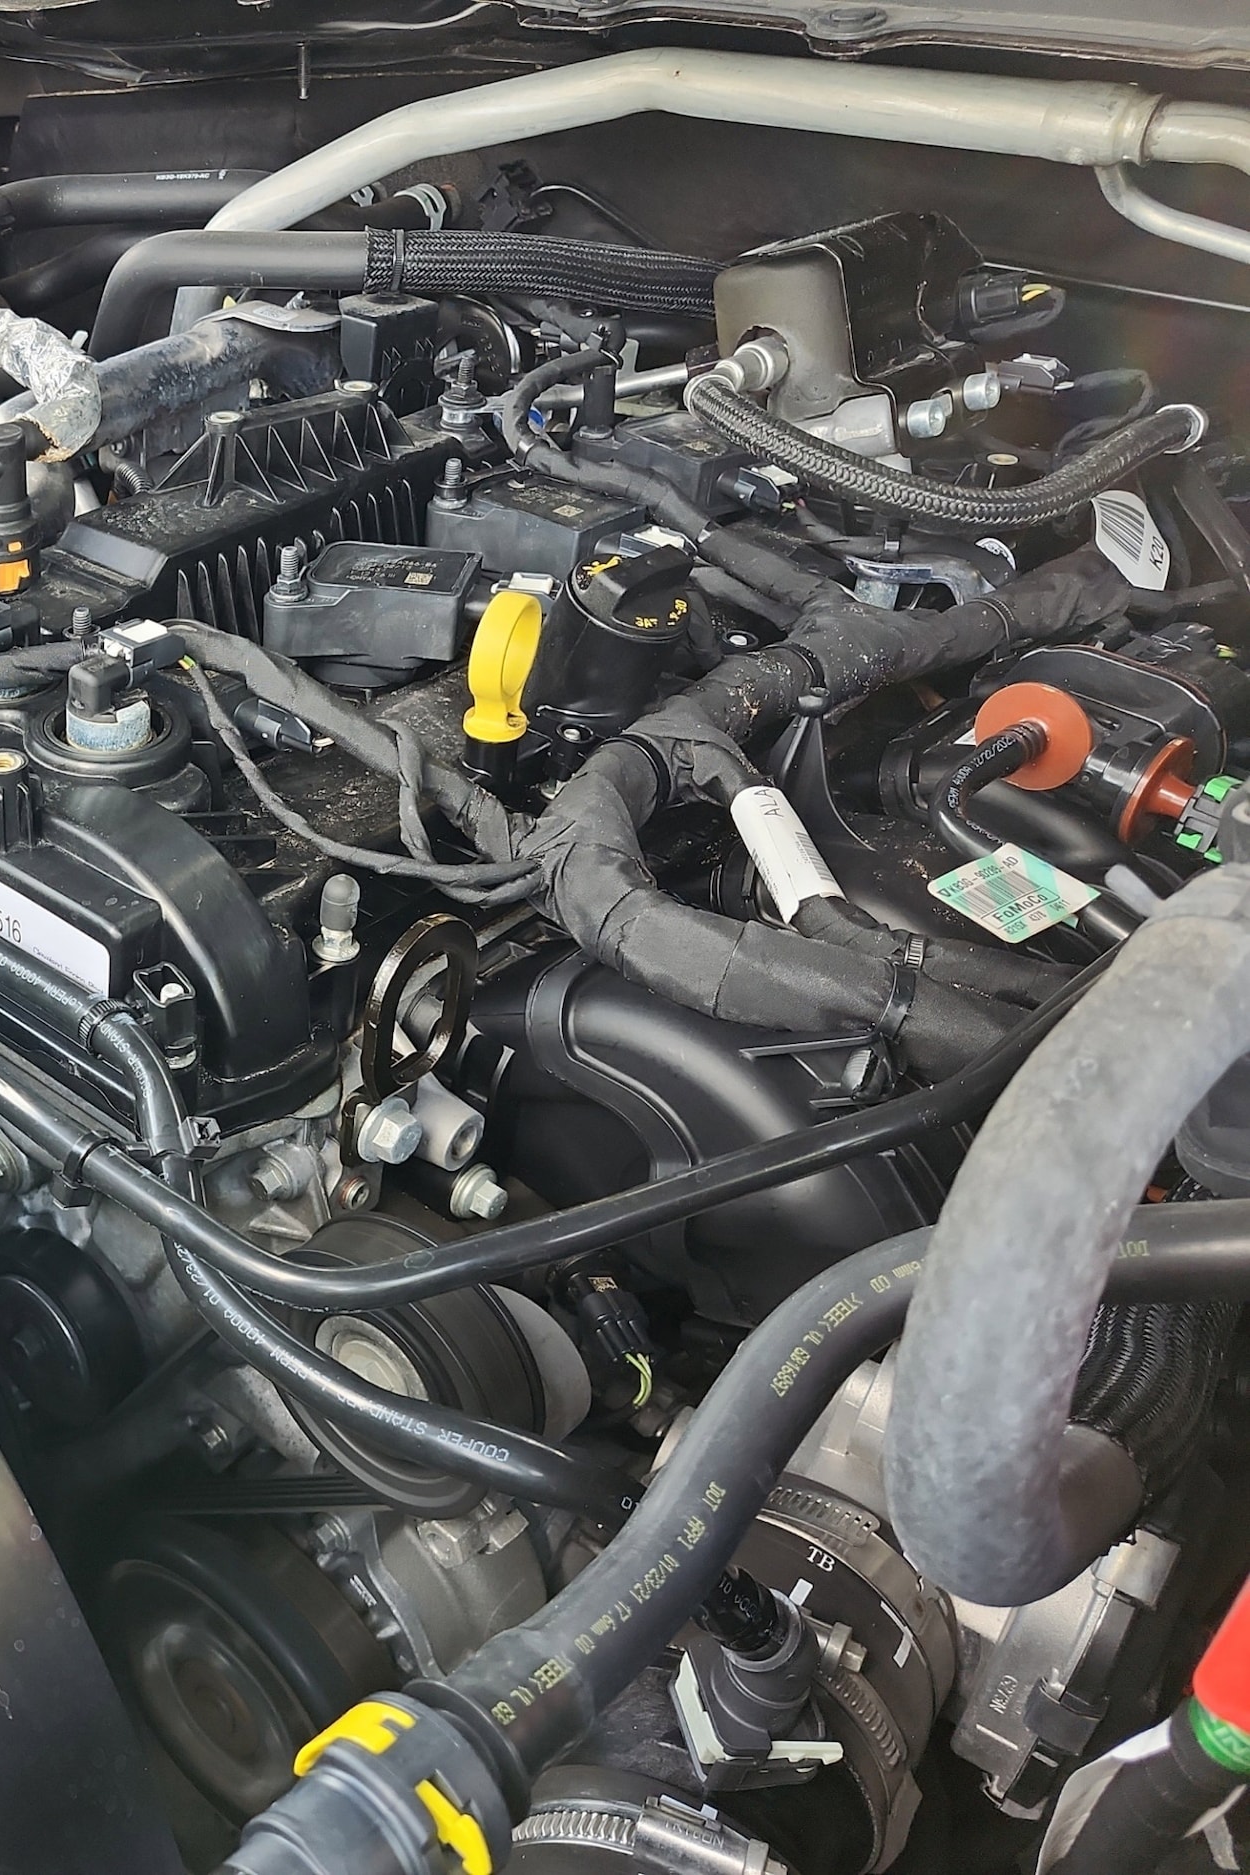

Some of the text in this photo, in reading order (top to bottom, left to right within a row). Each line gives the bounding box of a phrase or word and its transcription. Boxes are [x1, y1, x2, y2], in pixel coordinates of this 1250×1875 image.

[1149, 535, 1165, 571] K20
[754, 788, 784, 818] ALA
[993, 893, 1048, 923] FoMoCo
[8, 961, 43, 988] 4000A
[42, 981, 83, 1013] LoPERM
[221, 1303, 268, 1347] 4000A
[437, 1425, 510, 1463] COOPER
[806, 1545, 836, 1573] TB
[628, 1551, 679, 1603] 01/23/21
